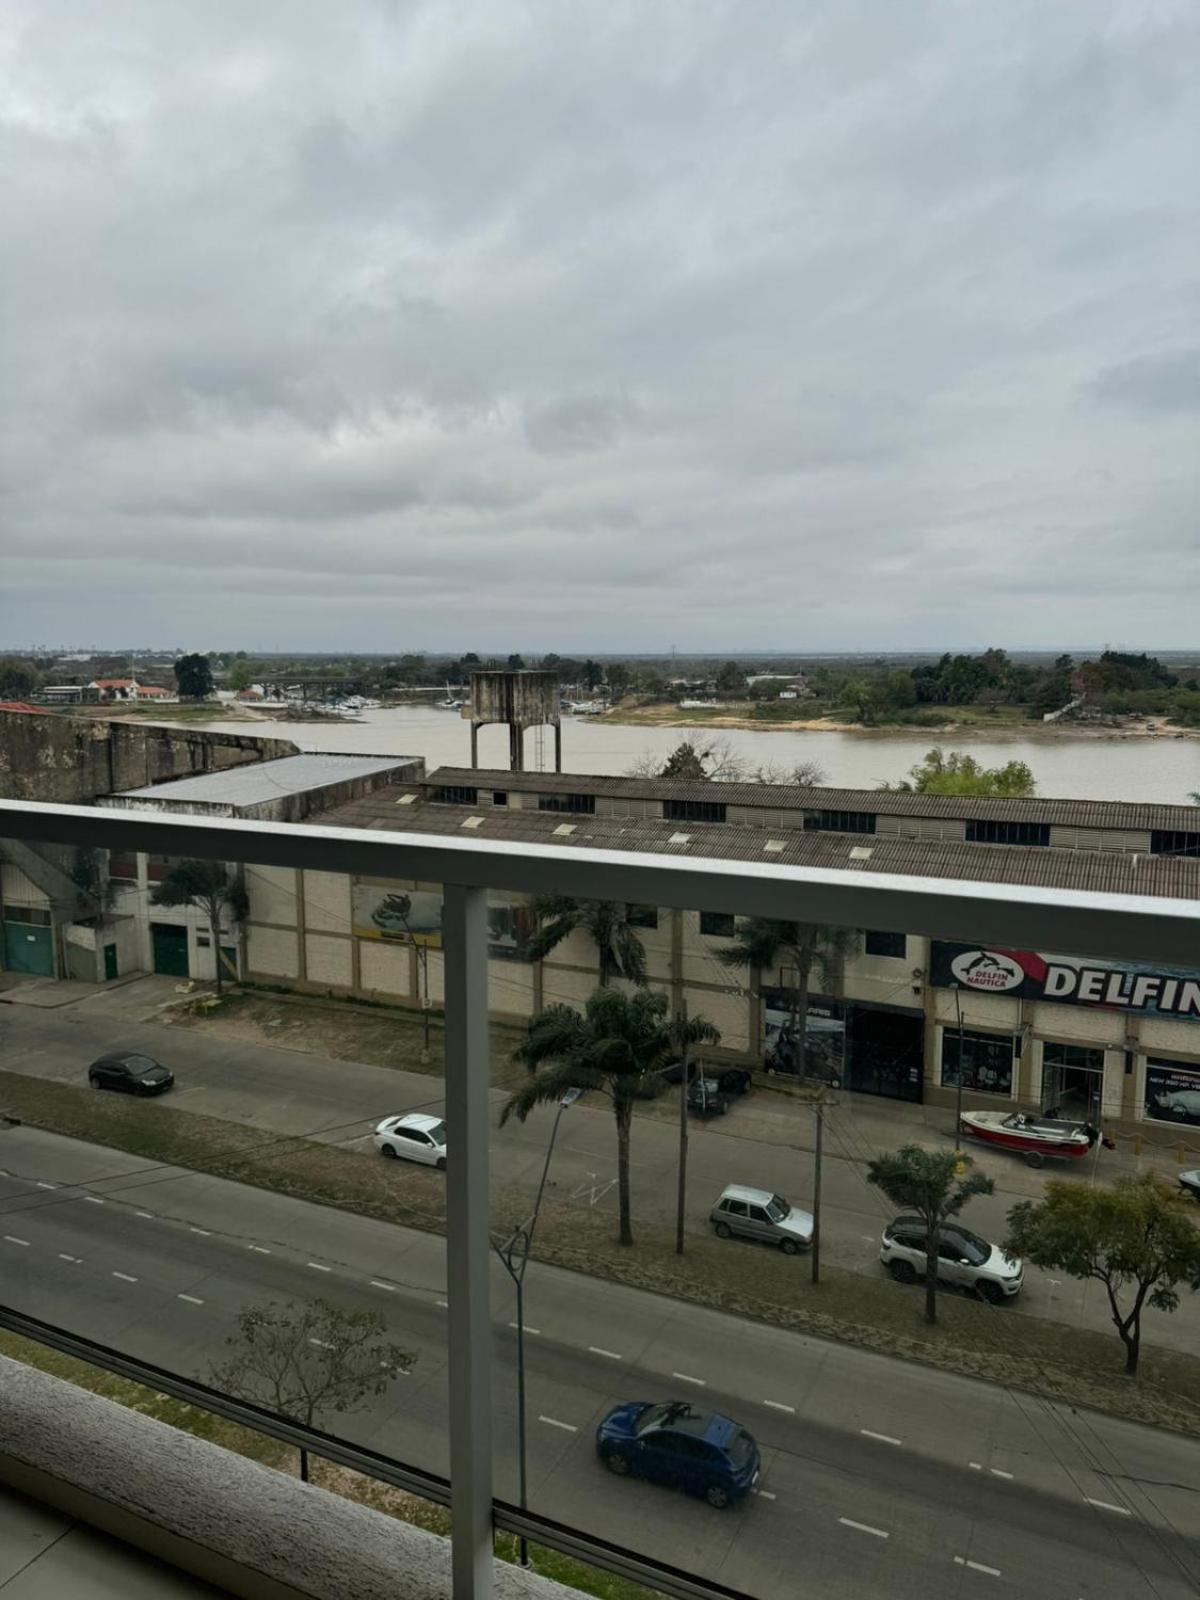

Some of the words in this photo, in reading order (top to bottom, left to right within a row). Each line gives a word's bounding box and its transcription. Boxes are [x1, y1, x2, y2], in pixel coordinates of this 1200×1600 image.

[975, 971, 1008, 981] DELFIN
[967, 977, 1006, 987] NAUTICA
[1044, 966, 1200, 1013] DELFIN
